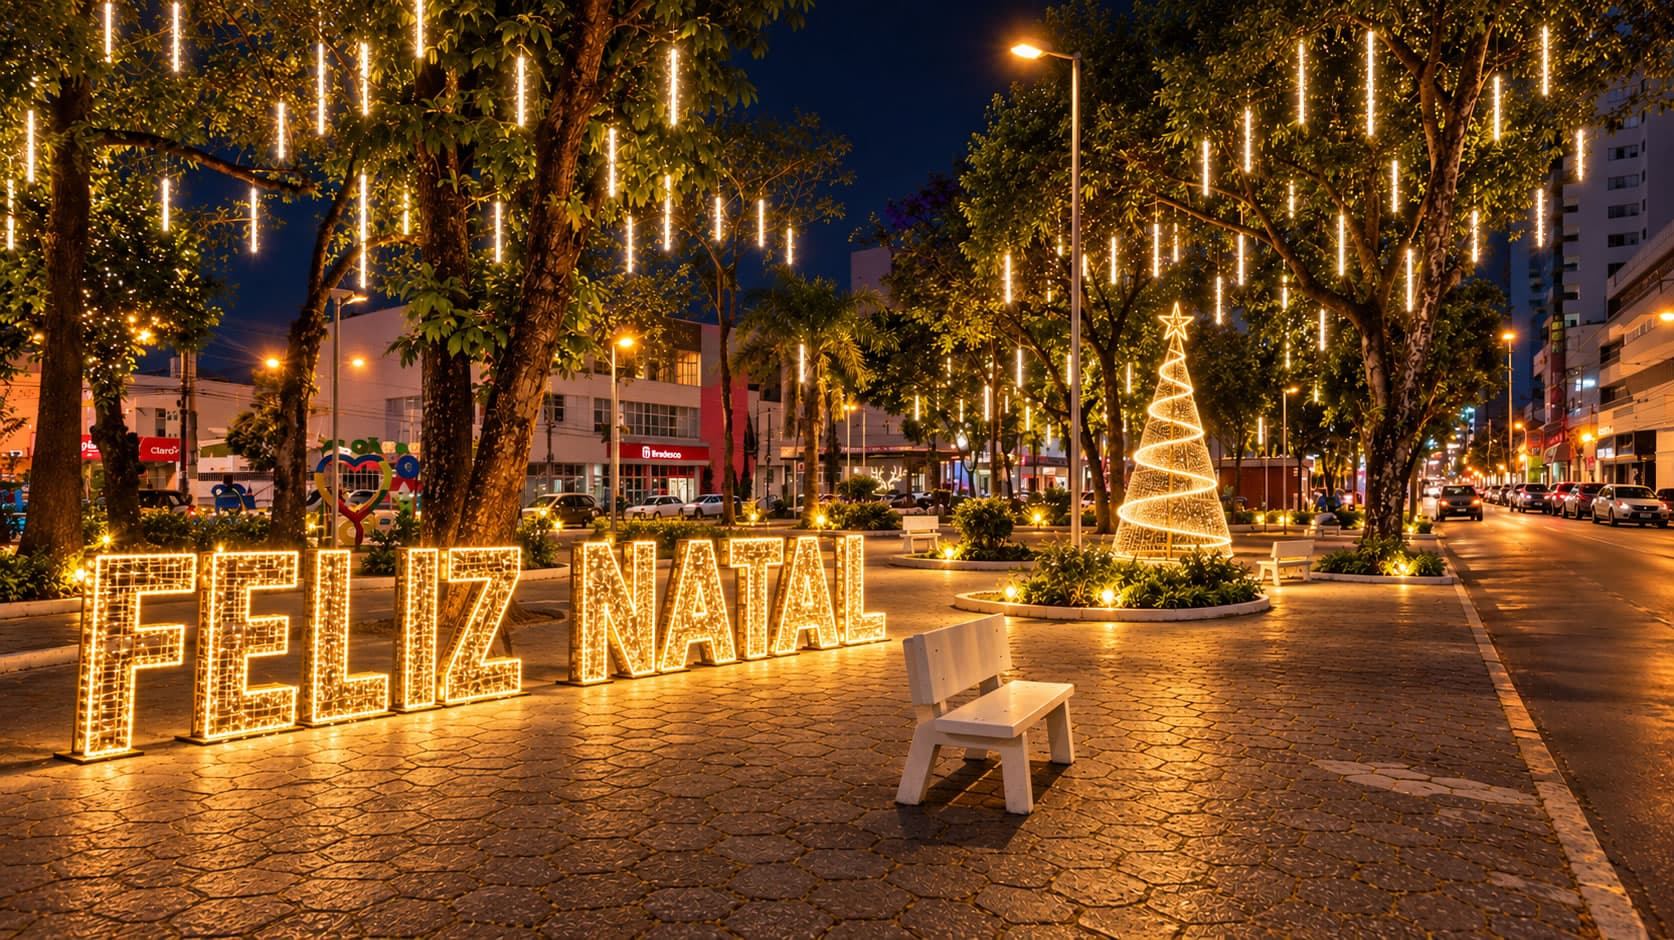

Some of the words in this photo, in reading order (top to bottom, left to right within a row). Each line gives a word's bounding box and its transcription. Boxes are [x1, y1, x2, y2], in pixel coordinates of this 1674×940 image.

[150, 446, 175, 455] Claro
[651, 449, 682, 459] Bradesco
[76, 546, 522, 759] FELIZ
[572, 534, 887, 683] NATAL
